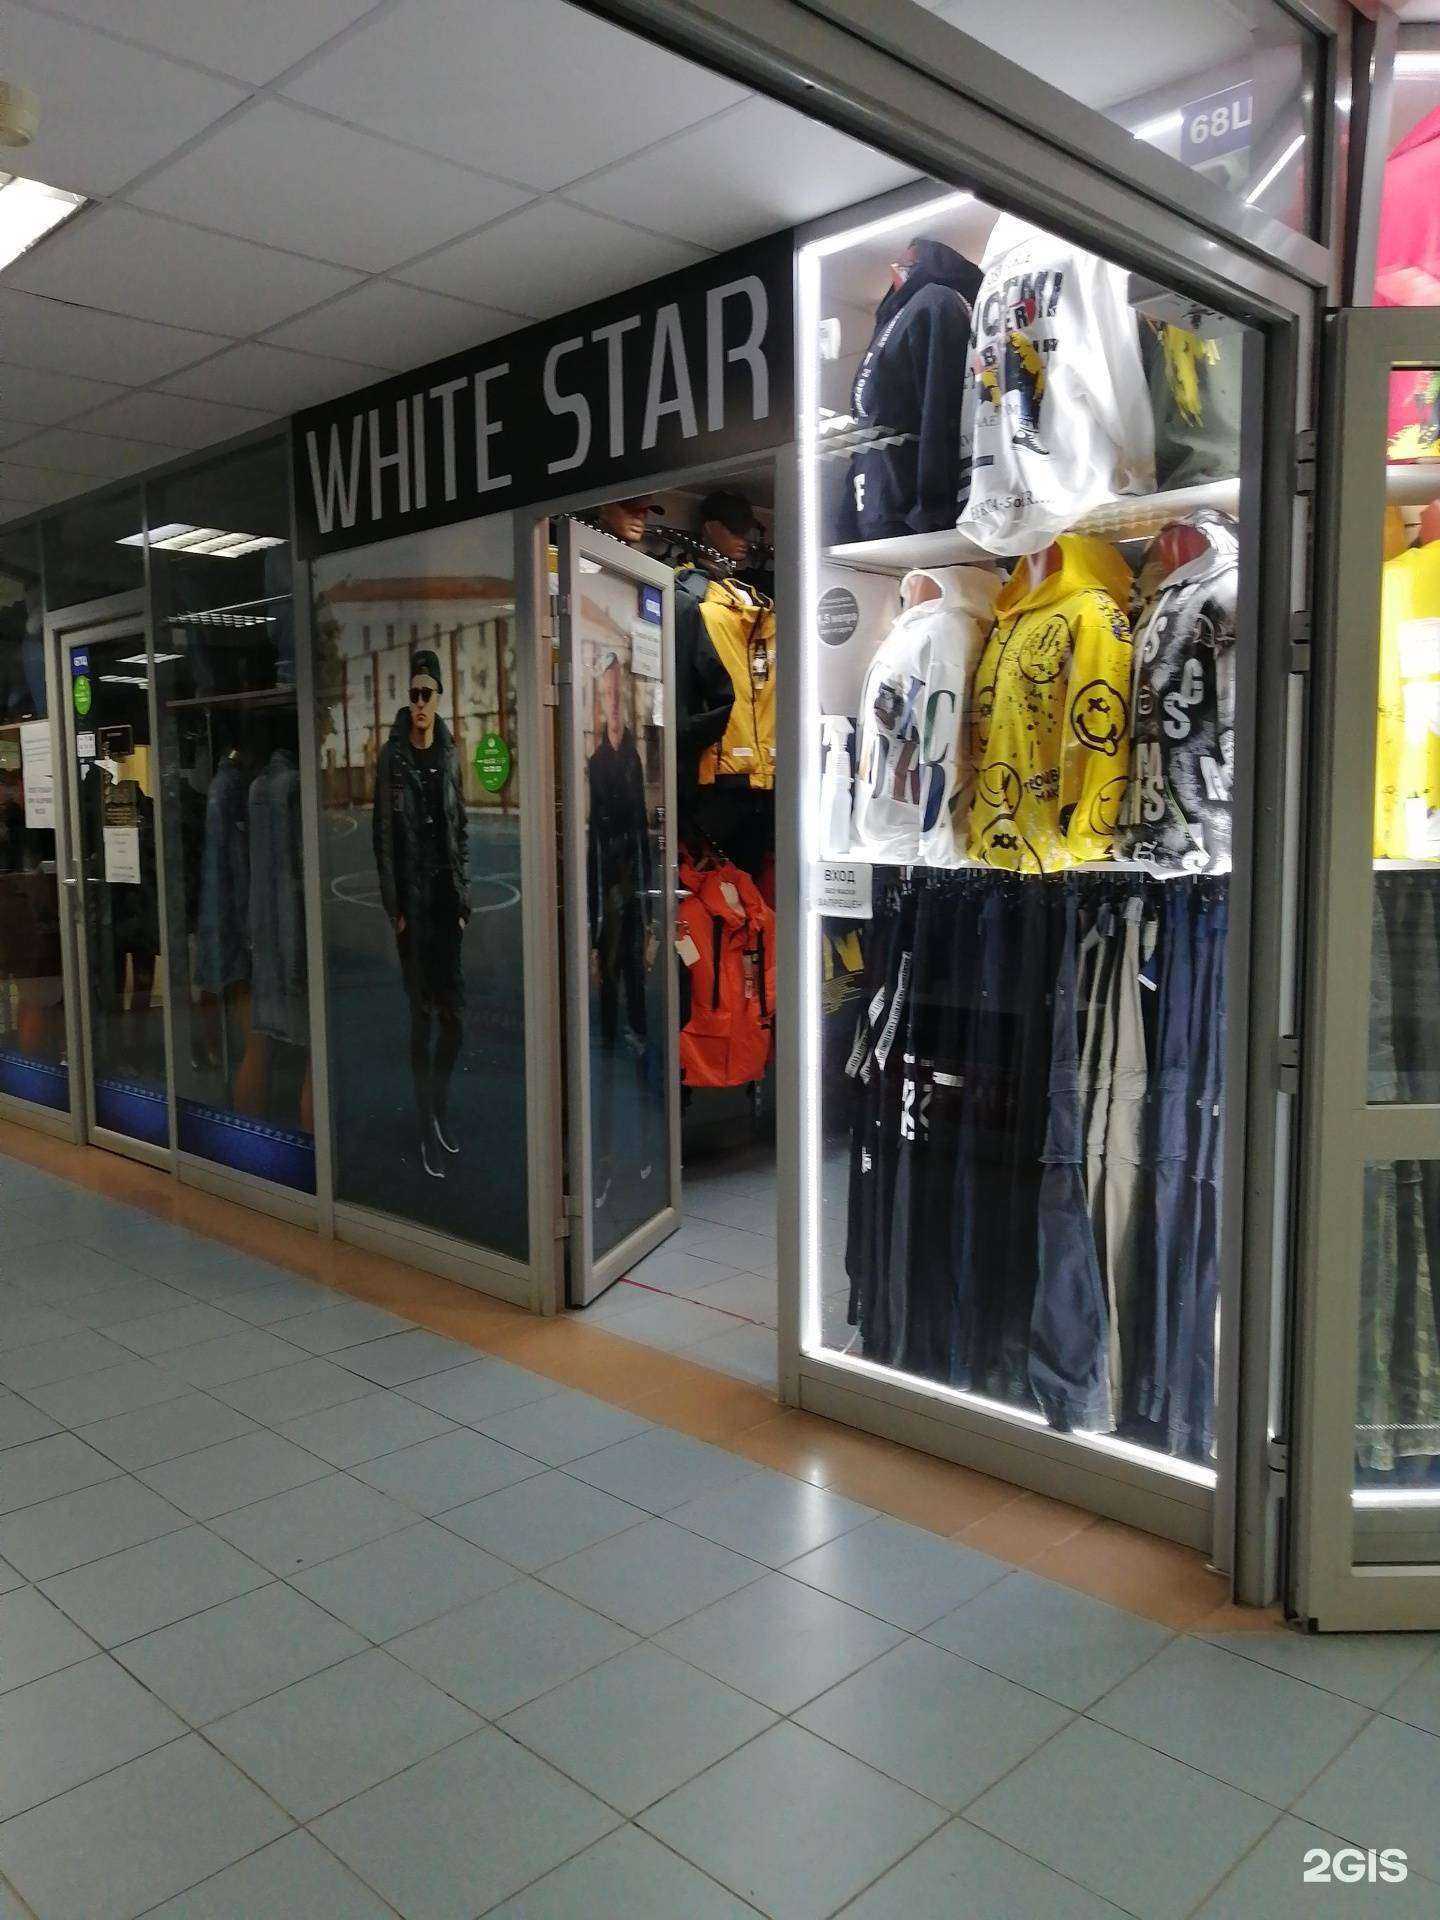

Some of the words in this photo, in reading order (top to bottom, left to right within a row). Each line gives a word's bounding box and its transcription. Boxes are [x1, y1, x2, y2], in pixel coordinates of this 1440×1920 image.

[306, 362, 513, 534] WHITE
[543, 275, 769, 475] STAR
[824, 869, 856, 884] ВХОД
